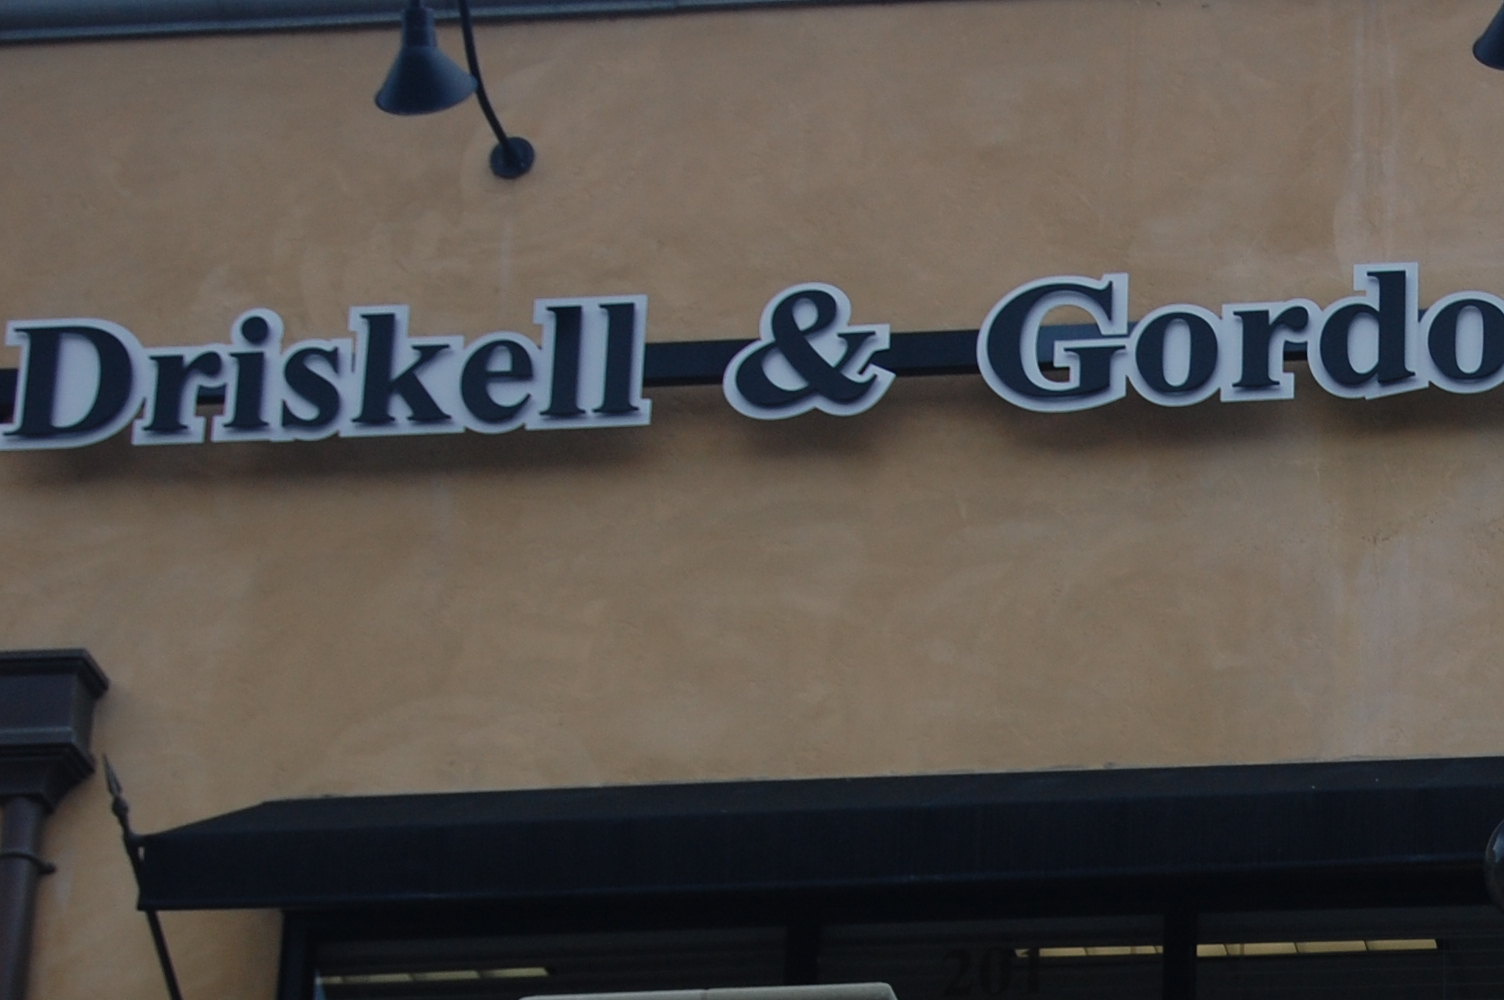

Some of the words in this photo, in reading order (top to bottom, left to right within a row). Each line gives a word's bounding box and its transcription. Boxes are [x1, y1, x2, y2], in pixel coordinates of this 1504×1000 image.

[2, 300, 643, 440] Driskell
[733, 287, 883, 407] &
[939, 944, 1043, 996] 201
